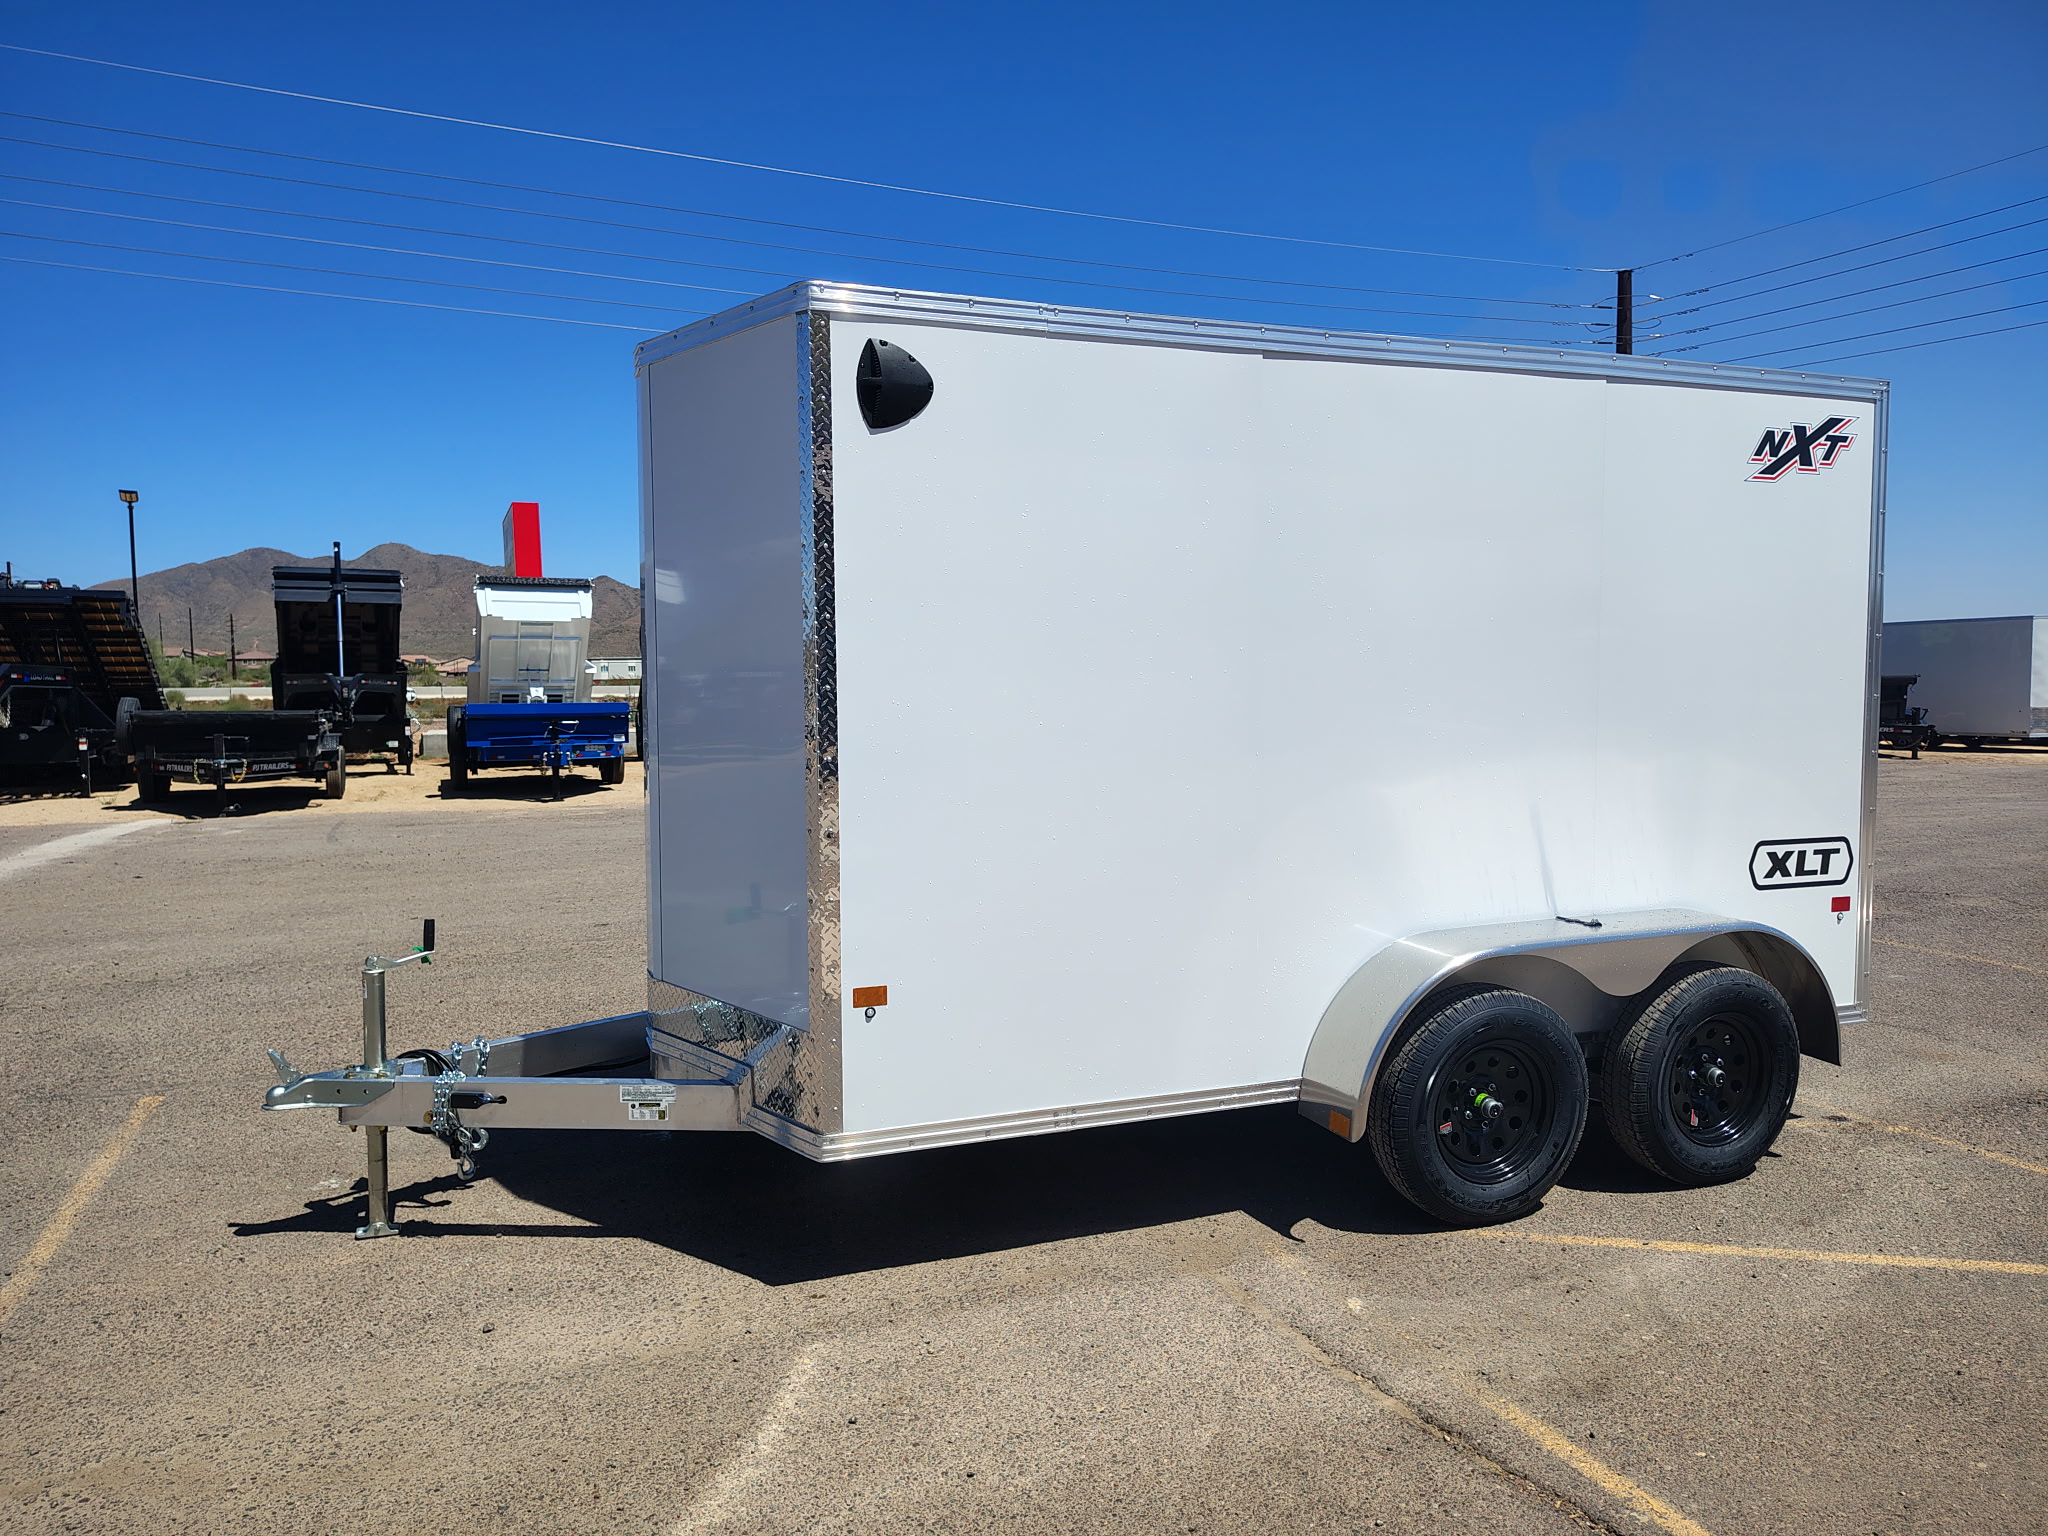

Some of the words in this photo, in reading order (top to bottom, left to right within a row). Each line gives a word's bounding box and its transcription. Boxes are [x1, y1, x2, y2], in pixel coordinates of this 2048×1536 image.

[1748, 415, 1858, 482] NXT
[172, 763, 193, 772] TRAILERS
[259, 761, 290, 771] TRAILERS
[1762, 847, 1841, 880] XLT
